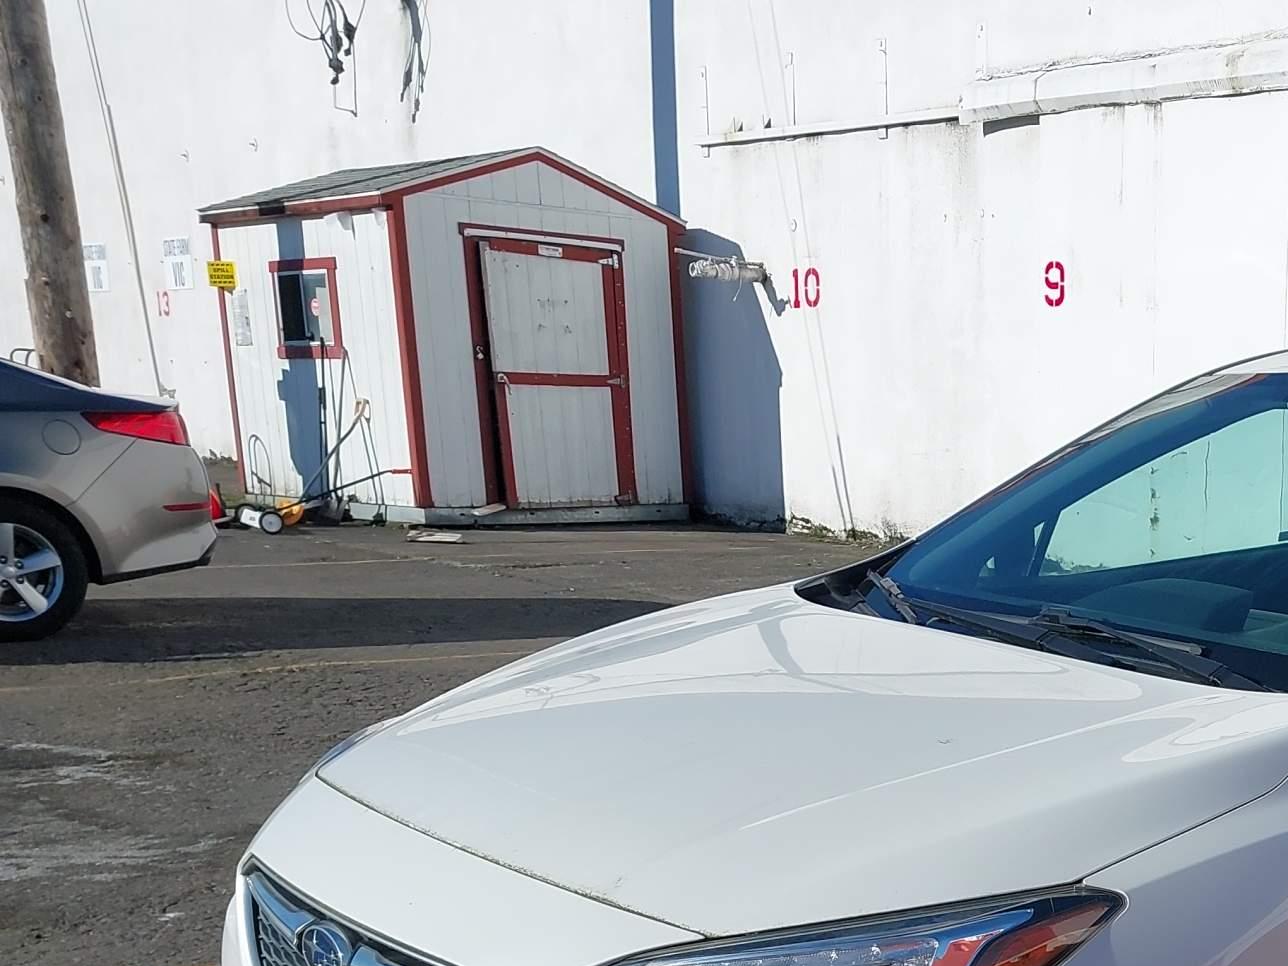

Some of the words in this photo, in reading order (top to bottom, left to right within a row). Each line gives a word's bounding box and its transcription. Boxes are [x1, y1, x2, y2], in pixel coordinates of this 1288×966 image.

[156, 290, 171, 317] 13
[792, 267, 821, 309] 10
[1044, 260, 1065, 308] 9
